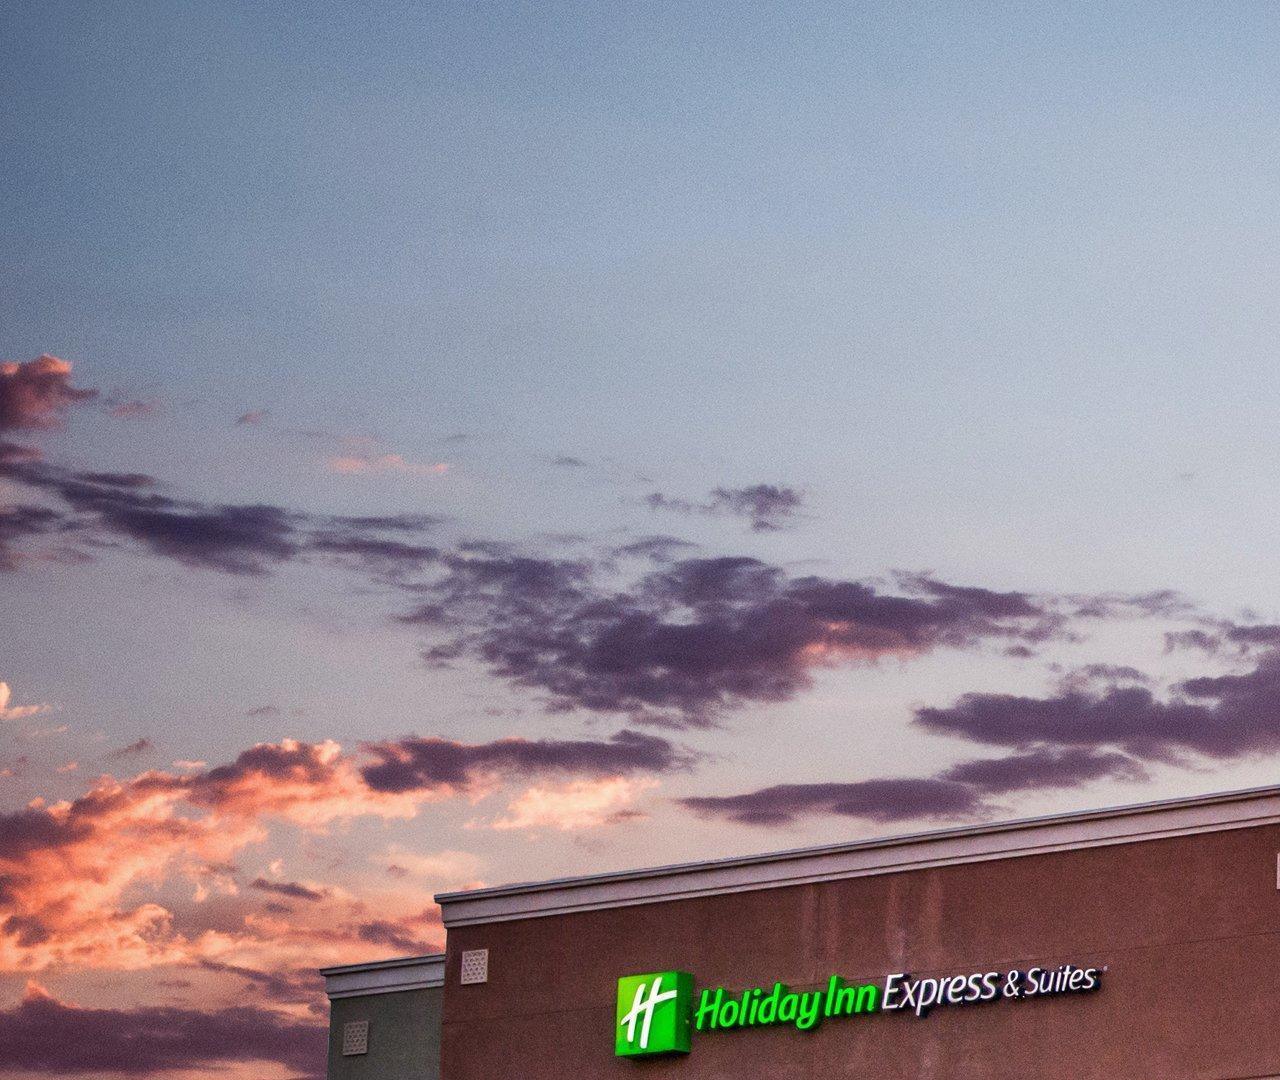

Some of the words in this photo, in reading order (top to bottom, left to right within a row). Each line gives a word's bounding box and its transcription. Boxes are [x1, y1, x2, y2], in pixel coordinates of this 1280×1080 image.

[695, 982, 821, 1031] Holiday
[825, 975, 877, 1017] Inn
[882, 972, 998, 1016] Express
[1003, 970, 1020, 997] &
[1025, 965, 1096, 995] Suites
